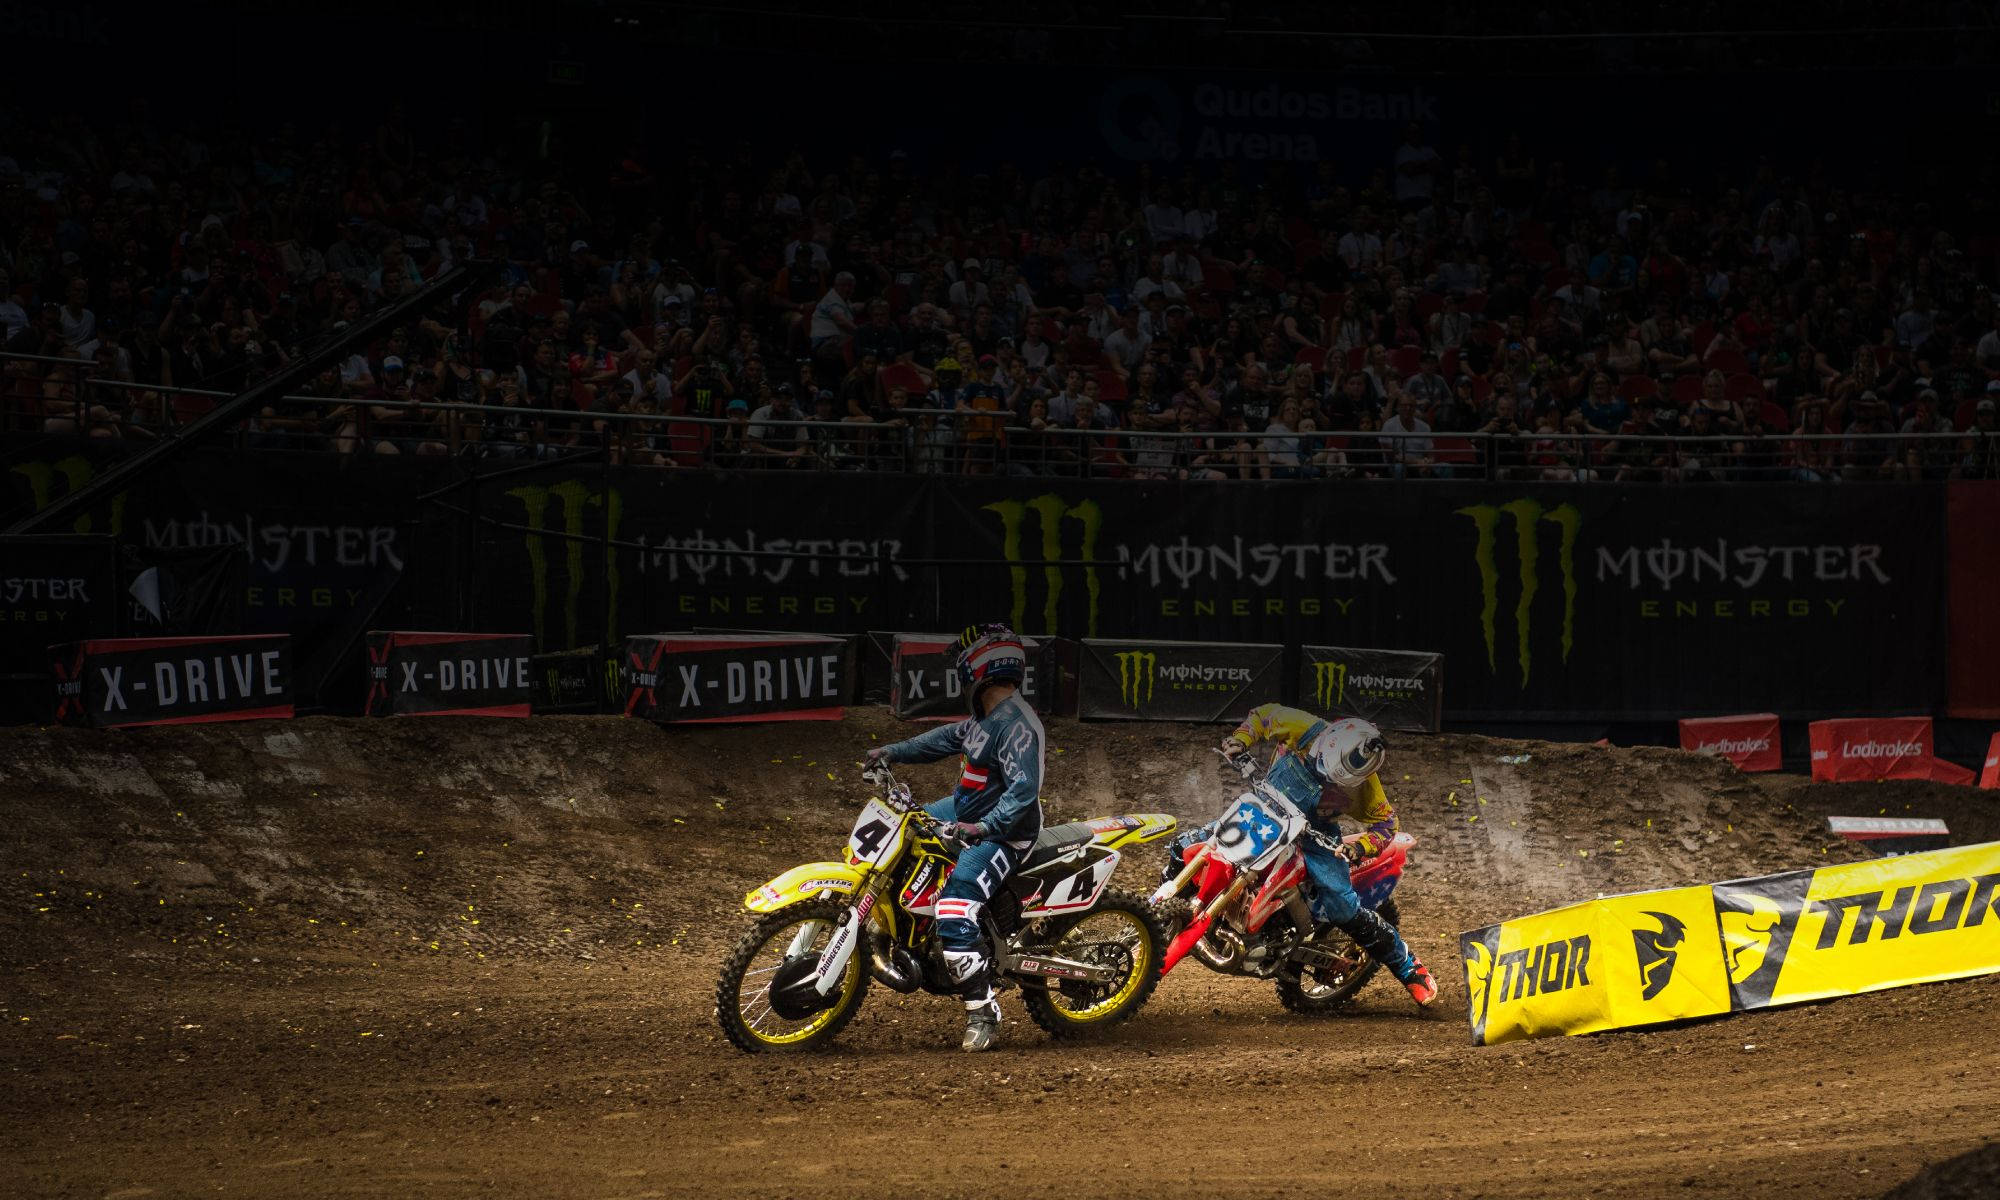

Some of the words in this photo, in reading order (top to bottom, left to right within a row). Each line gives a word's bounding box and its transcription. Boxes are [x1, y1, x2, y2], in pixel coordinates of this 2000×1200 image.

[1194, 126, 1320, 161] Arena
[637, 528, 910, 585] MONSTER
[1117, 535, 1398, 589] MONSTER
[1595, 537, 1892, 591] MONSTER
[0, 576, 91, 603] STER
[245, 587, 366, 607] ERGY
[679, 595, 873, 615] ENERGY
[1161, 598, 1359, 616] ENERGY
[1640, 599, 1847, 617] ENERGY
[101, 650, 284, 712] X-DRIVE
[401, 657, 530, 693] X-DRIVE
[679, 655, 840, 707] X-DRIVE
[1159, 663, 1253, 683] MONSTER
[1348, 673, 1424, 692] MONSTER
[1698, 737, 1771, 754] Ladbrokes
[1843, 740, 1923, 759] Ladbrokes
[855, 818, 892, 858] 4
[911, 863, 934, 892] SUZUKI
[1067, 865, 1098, 902] 4
[1807, 872, 2000, 951] THOR
[817, 926, 851, 978] BRIDGESTONE
[1498, 934, 1591, 1004] THOR
